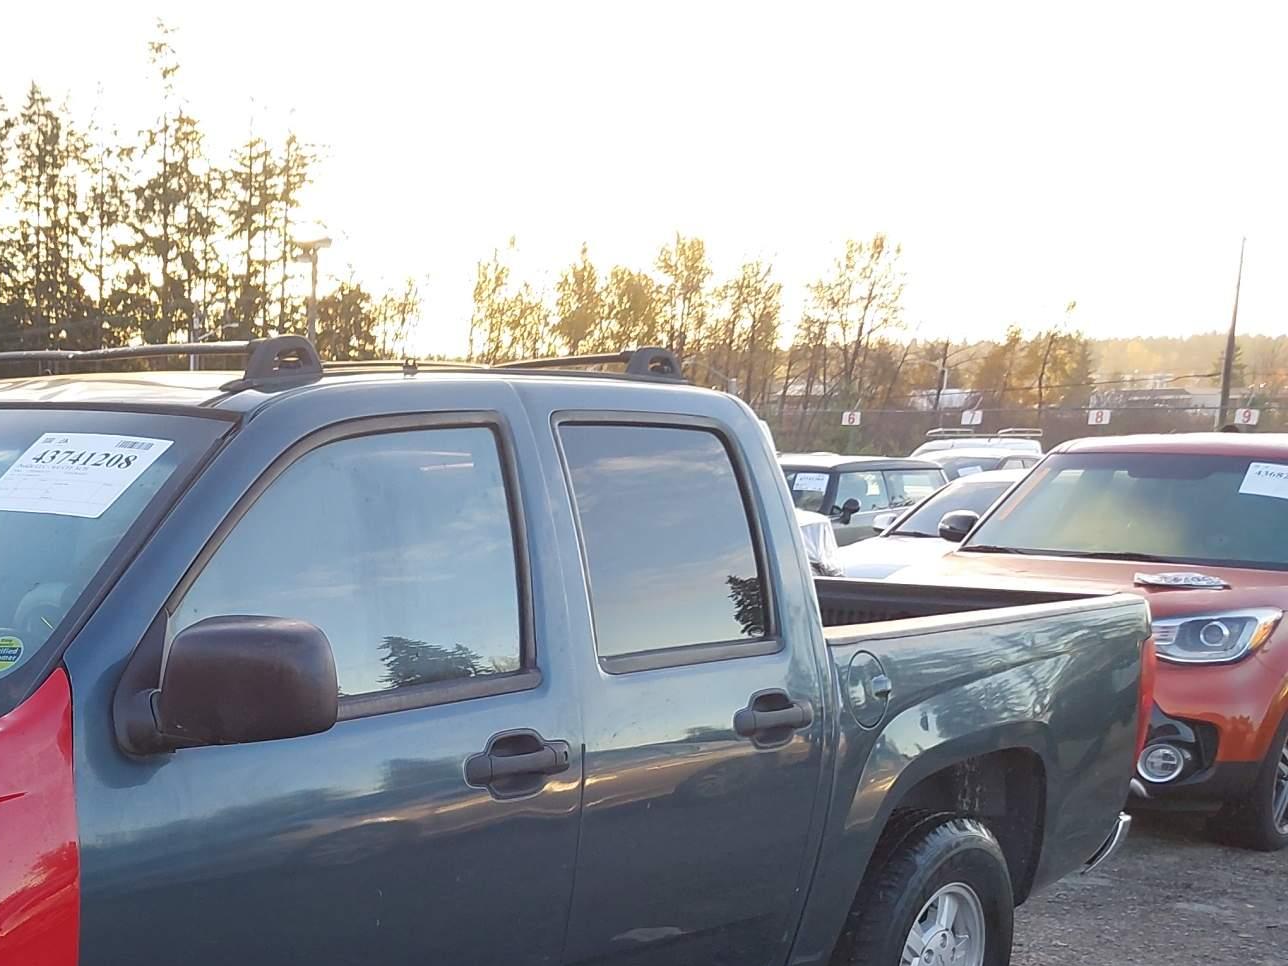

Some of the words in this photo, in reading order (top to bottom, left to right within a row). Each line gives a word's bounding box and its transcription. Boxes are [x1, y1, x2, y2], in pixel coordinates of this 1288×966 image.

[848, 413, 856, 425] 6
[1095, 411, 1104, 423] 8
[1242, 410, 1251, 423] 9
[32, 449, 138, 469] 43741208
